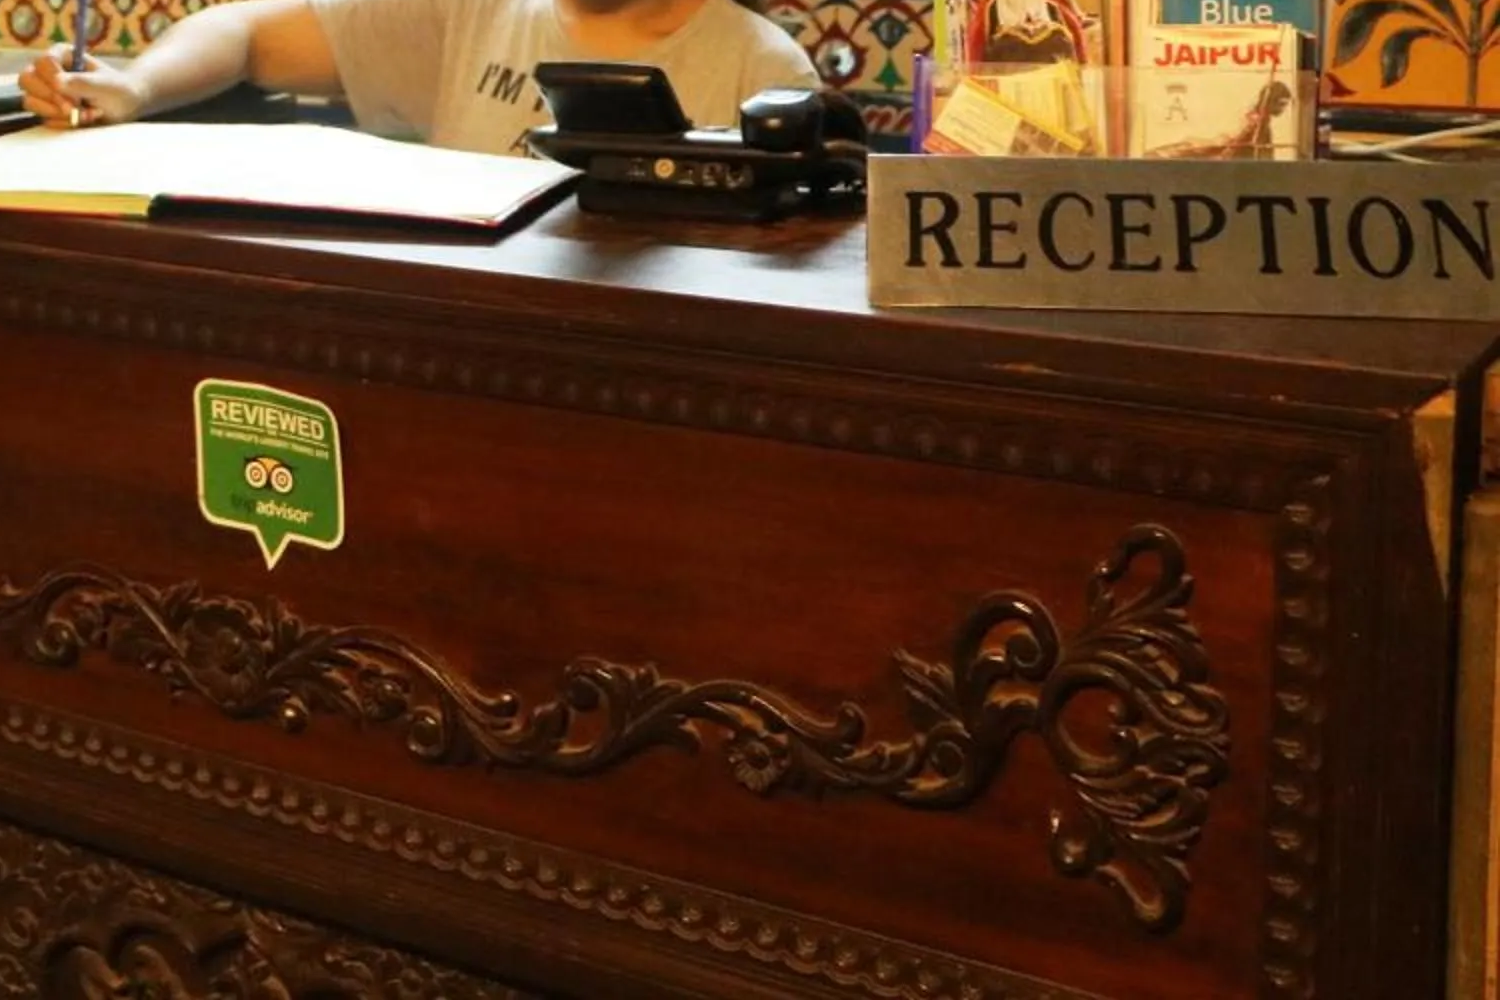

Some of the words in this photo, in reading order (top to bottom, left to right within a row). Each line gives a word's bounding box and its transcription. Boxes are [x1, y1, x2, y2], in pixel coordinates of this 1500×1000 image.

[1154, 43, 1280, 66] JAIPUR
[477, 63, 526, 105] I'M
[904, 191, 1495, 280] RECEPTION
[212, 400, 325, 440] REVIEWED
